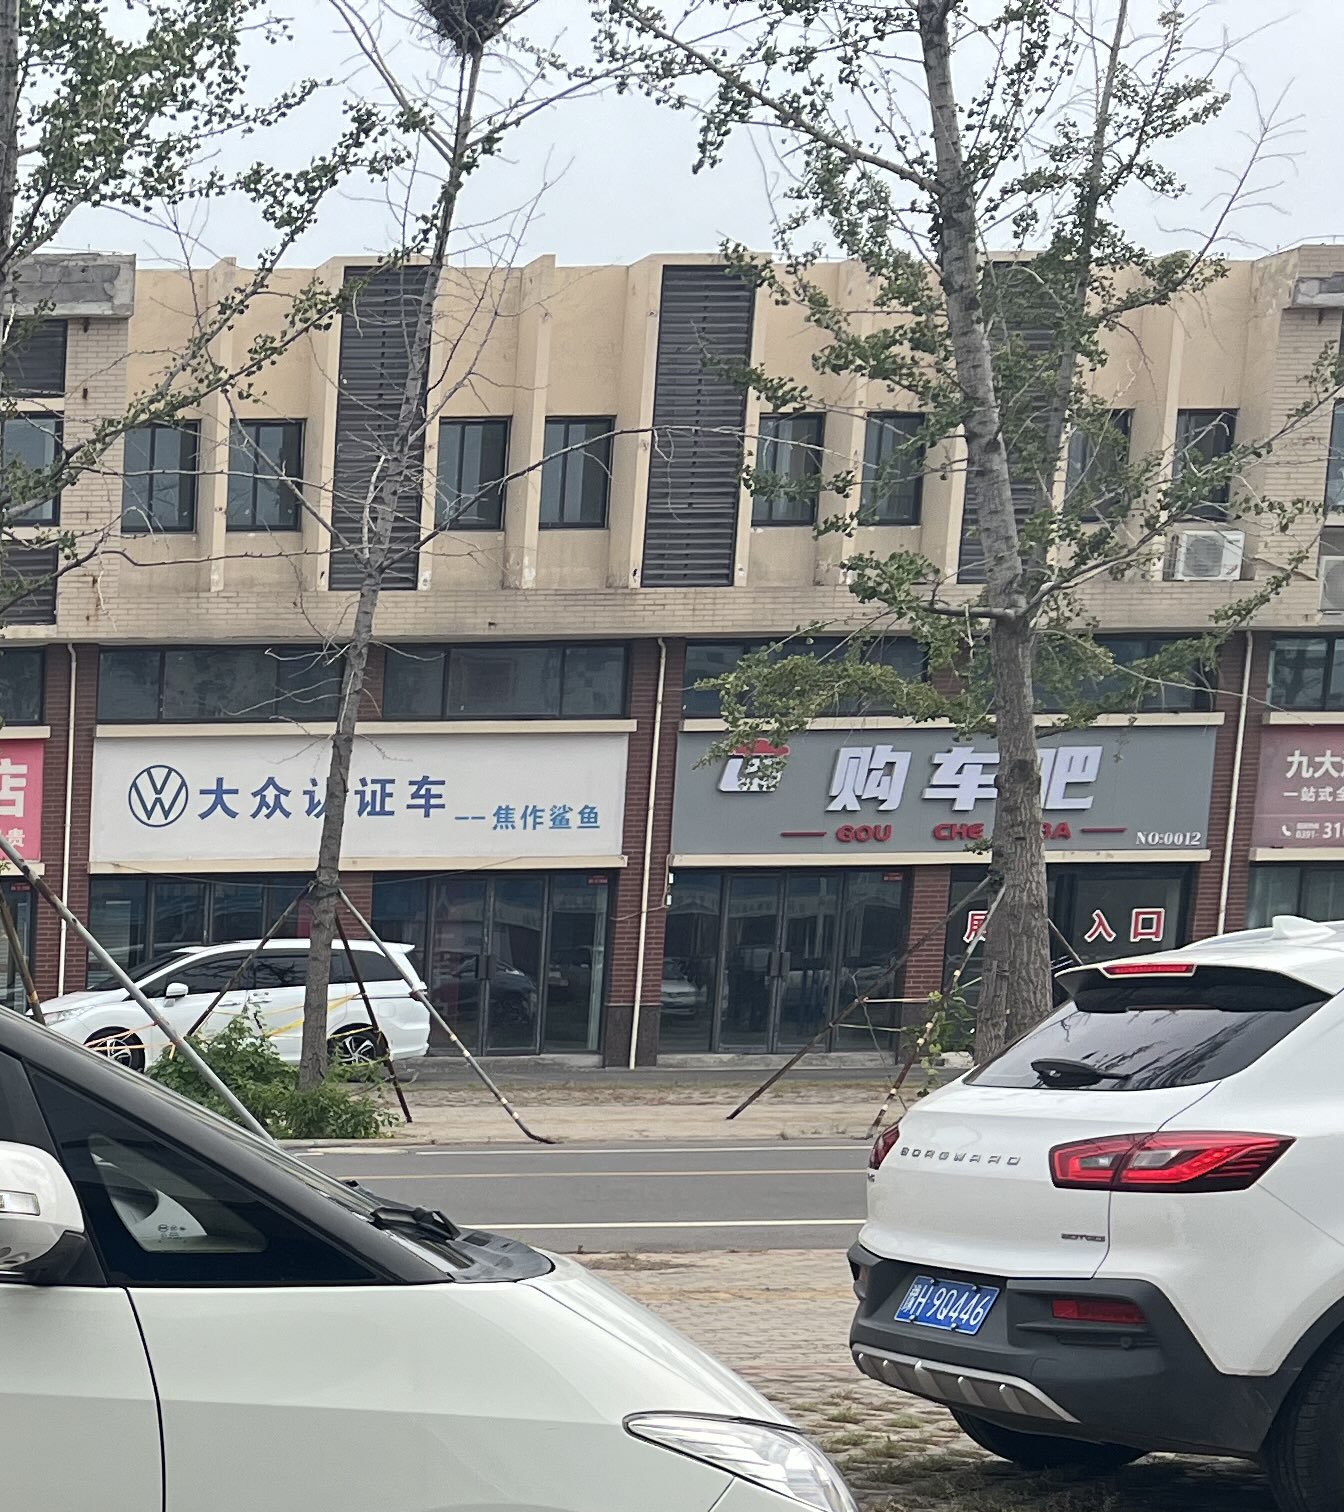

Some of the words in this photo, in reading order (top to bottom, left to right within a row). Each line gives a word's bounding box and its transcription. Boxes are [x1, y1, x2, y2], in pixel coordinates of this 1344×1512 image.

[1286, 749, 1344, 778] 九大
[836, 824, 892, 843] GOU
[933, 823, 985, 841] CHE
[1135, 831, 1202, 846] NO:0012
[1322, 822, 1344, 839] 31
[1084, 907, 1166, 943] 入口
